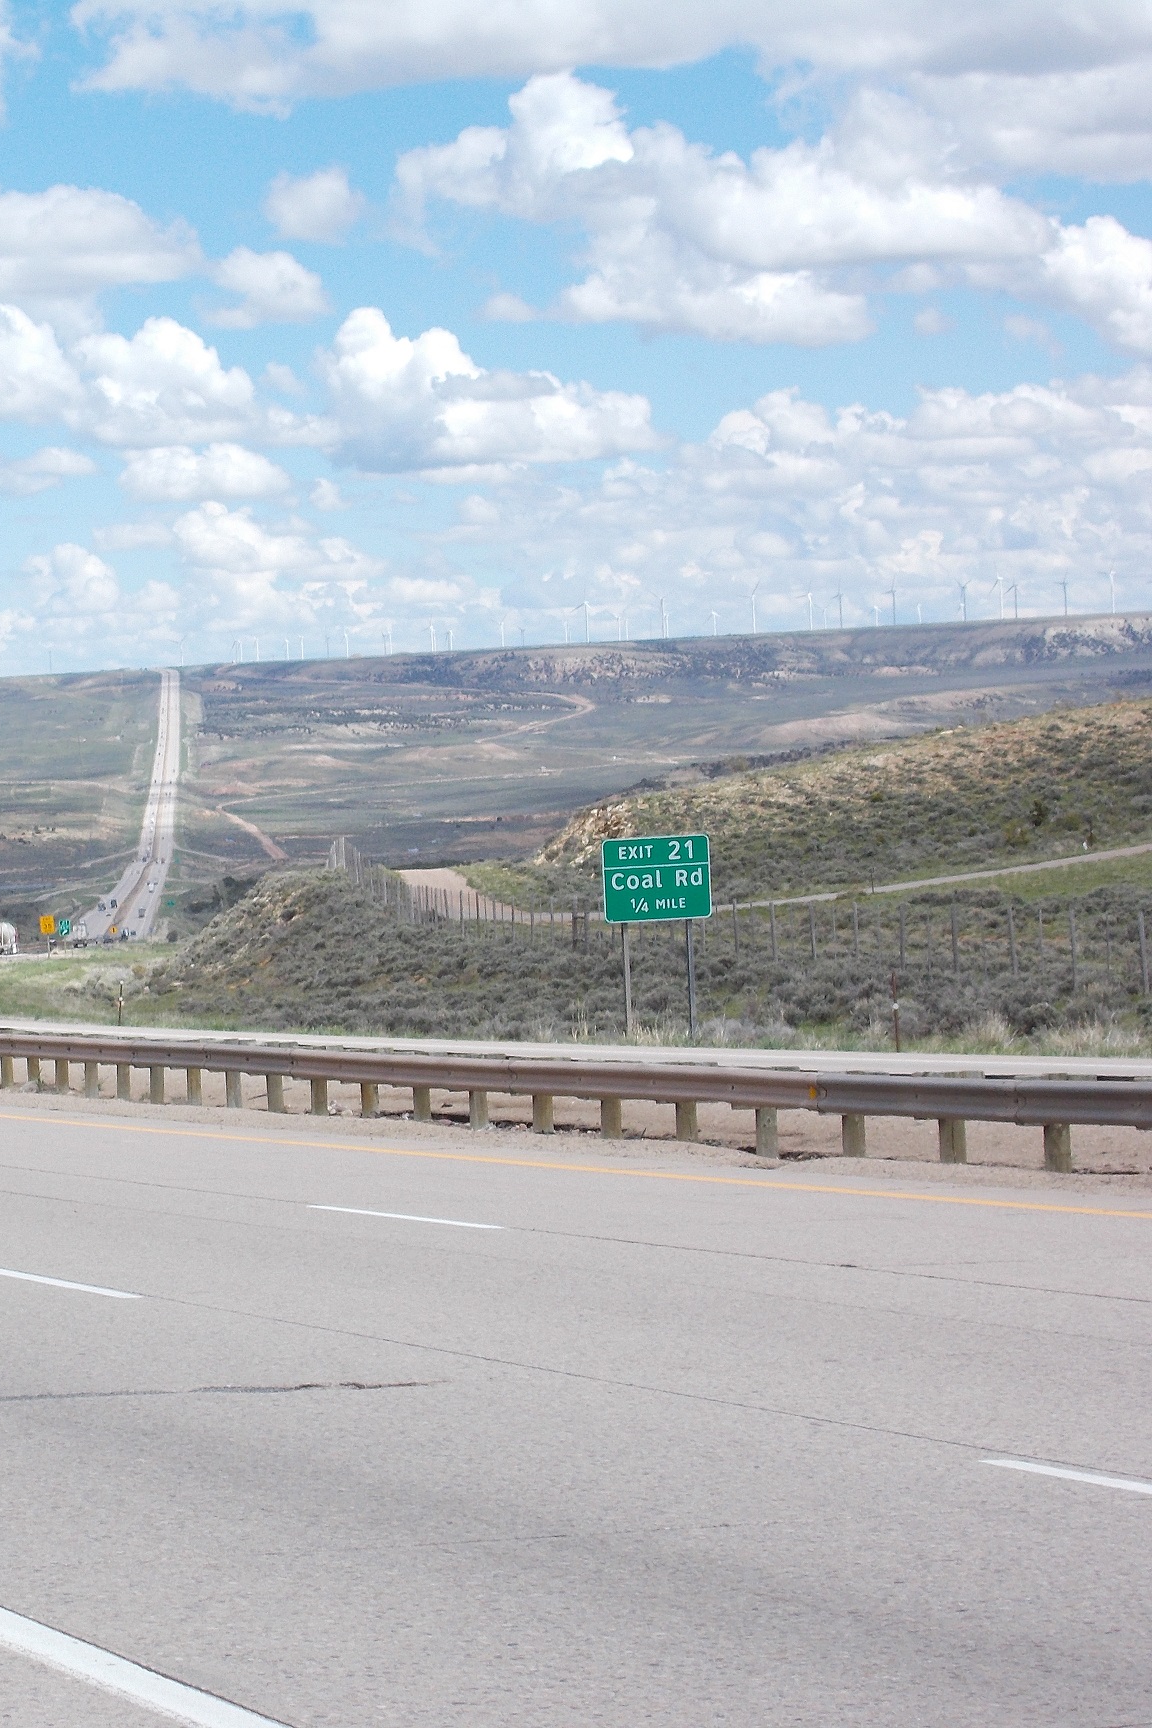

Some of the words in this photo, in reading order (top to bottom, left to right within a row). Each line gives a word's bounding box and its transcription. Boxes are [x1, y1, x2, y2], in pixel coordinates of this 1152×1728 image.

[618, 845, 653, 860] EXIT
[668, 839, 694, 860] 21
[611, 869, 663, 891] Coal
[675, 867, 703, 887] Rd
[655, 897, 687, 910] MILE
